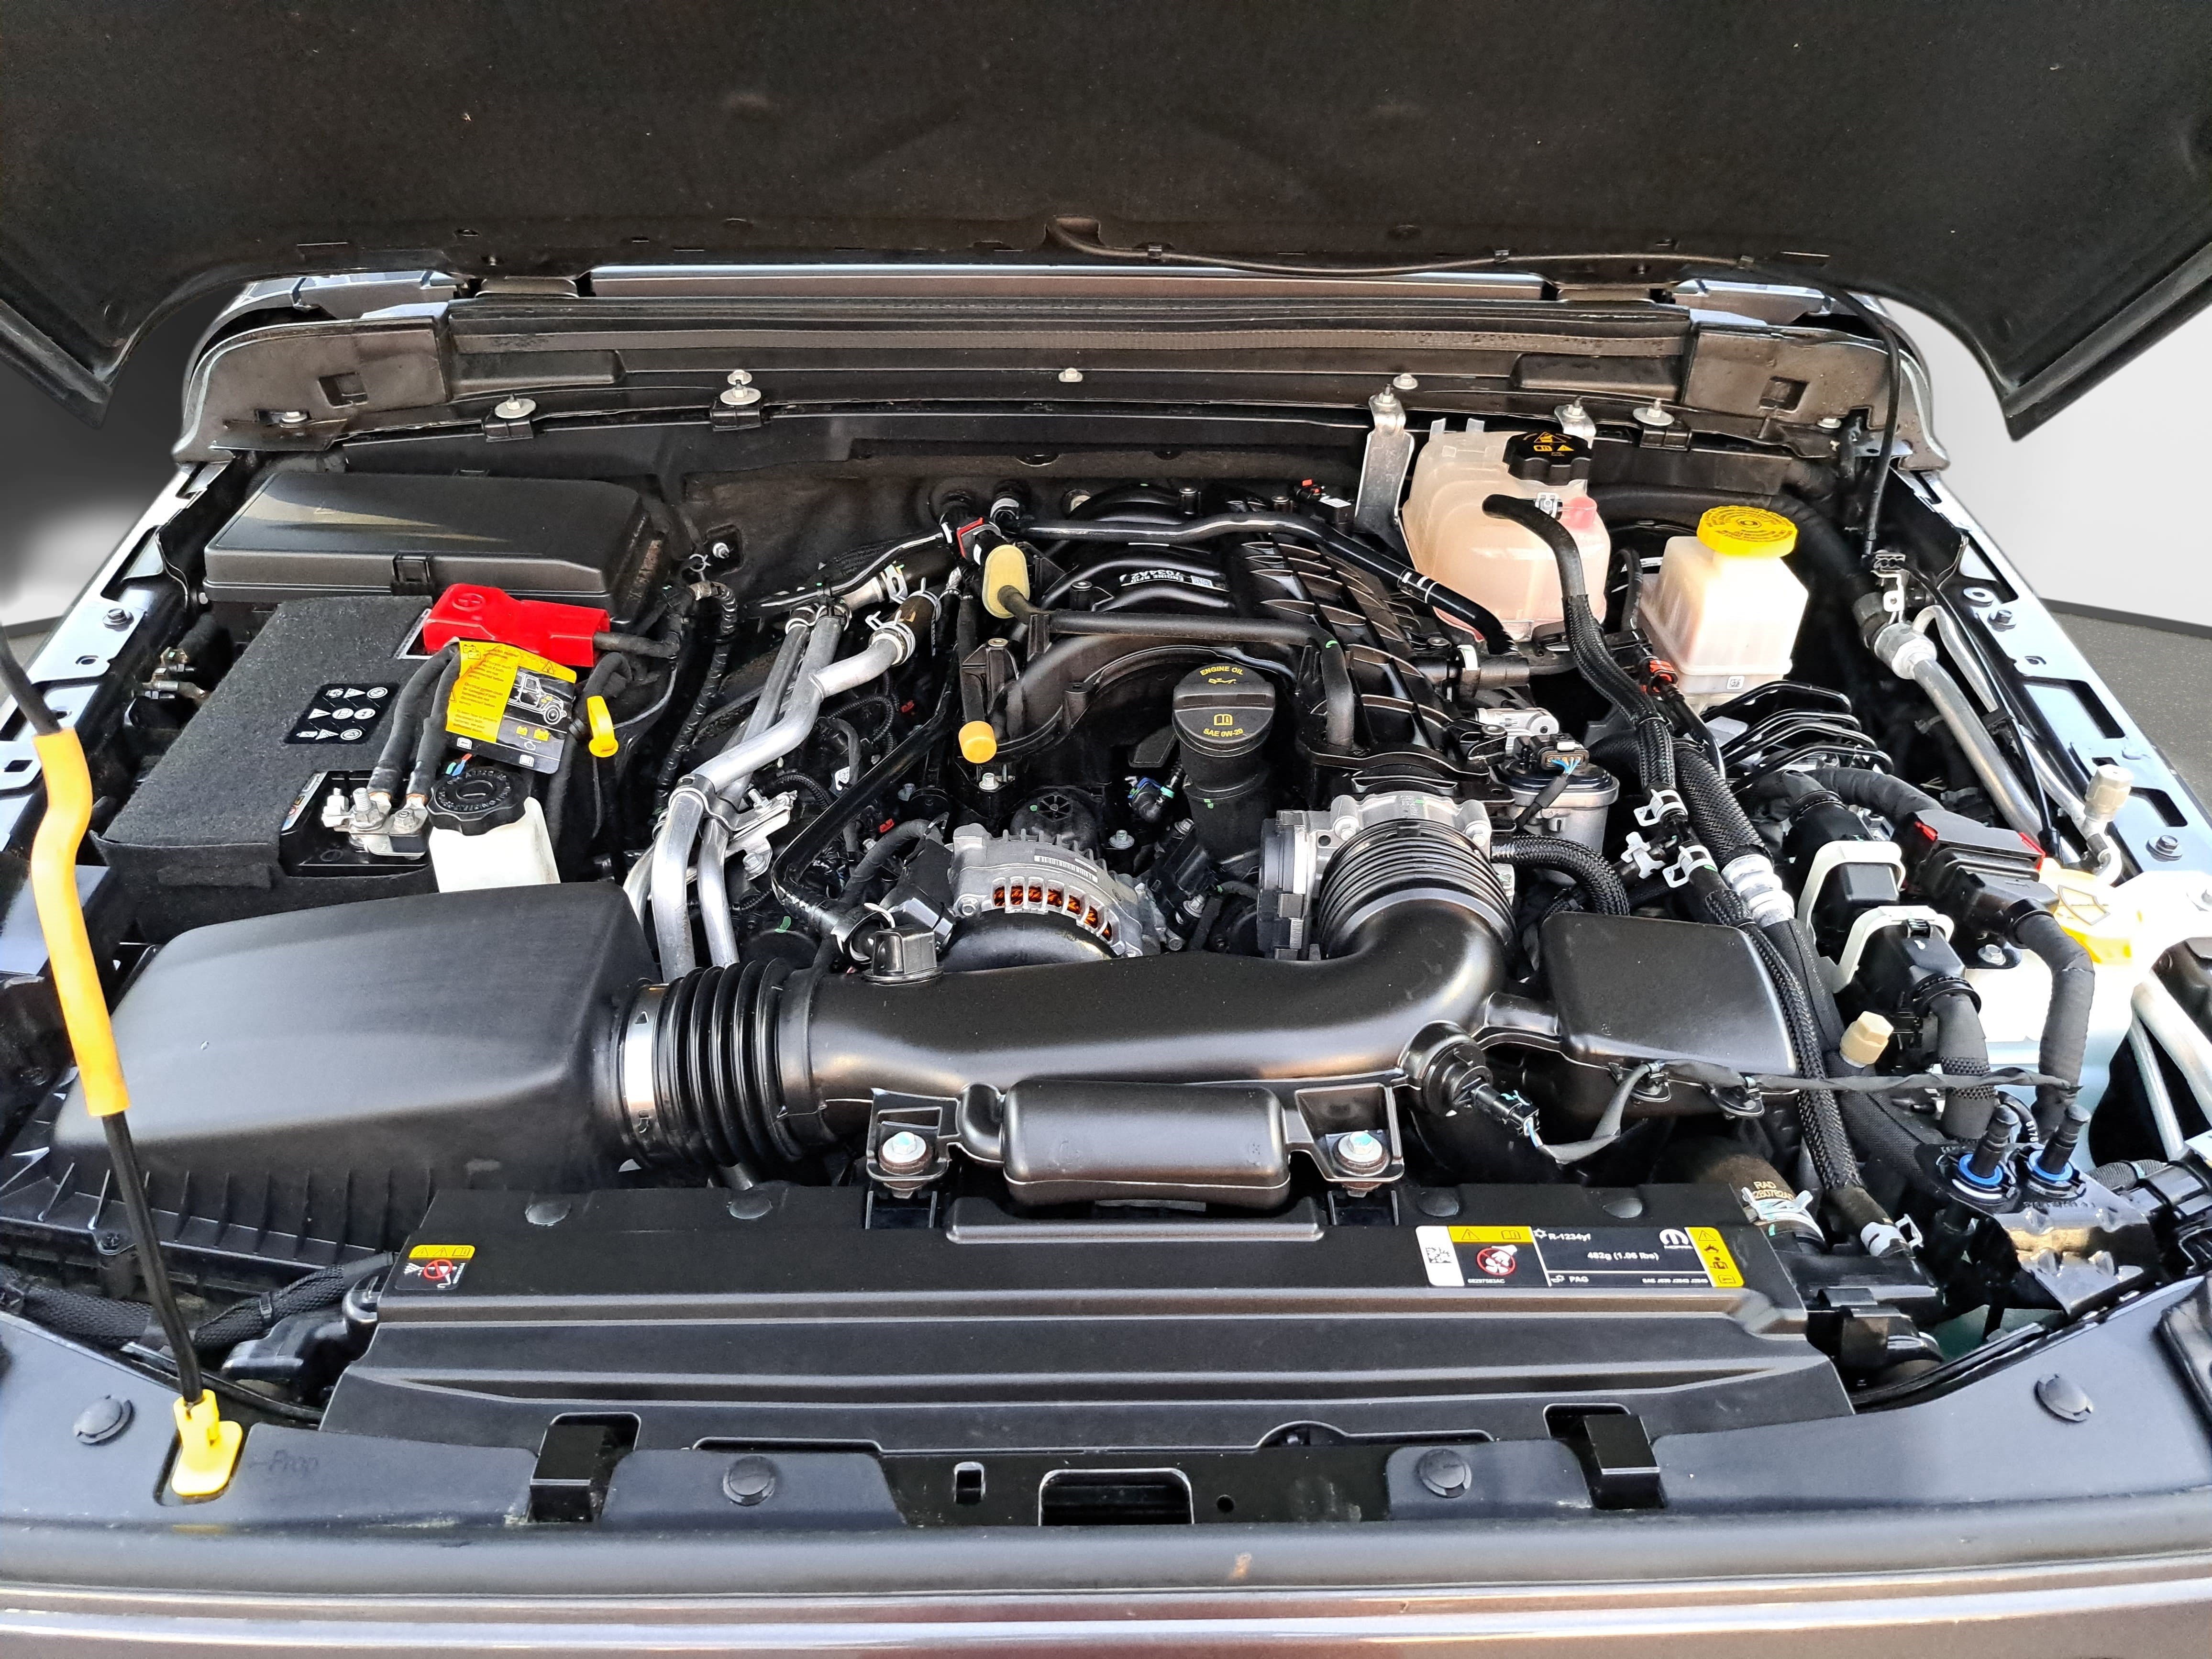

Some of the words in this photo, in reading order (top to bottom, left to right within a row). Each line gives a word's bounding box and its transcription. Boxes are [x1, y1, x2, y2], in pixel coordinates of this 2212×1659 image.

[1131, 575, 1150, 583] RFID
[1200, 666, 1229, 676] ENGINE
[1231, 667, 1244, 675] OIL
[1203, 728, 1219, 737] SAE
[1220, 728, 1243, 737] 0W-20
[1753, 1181, 1777, 1189] RAD
